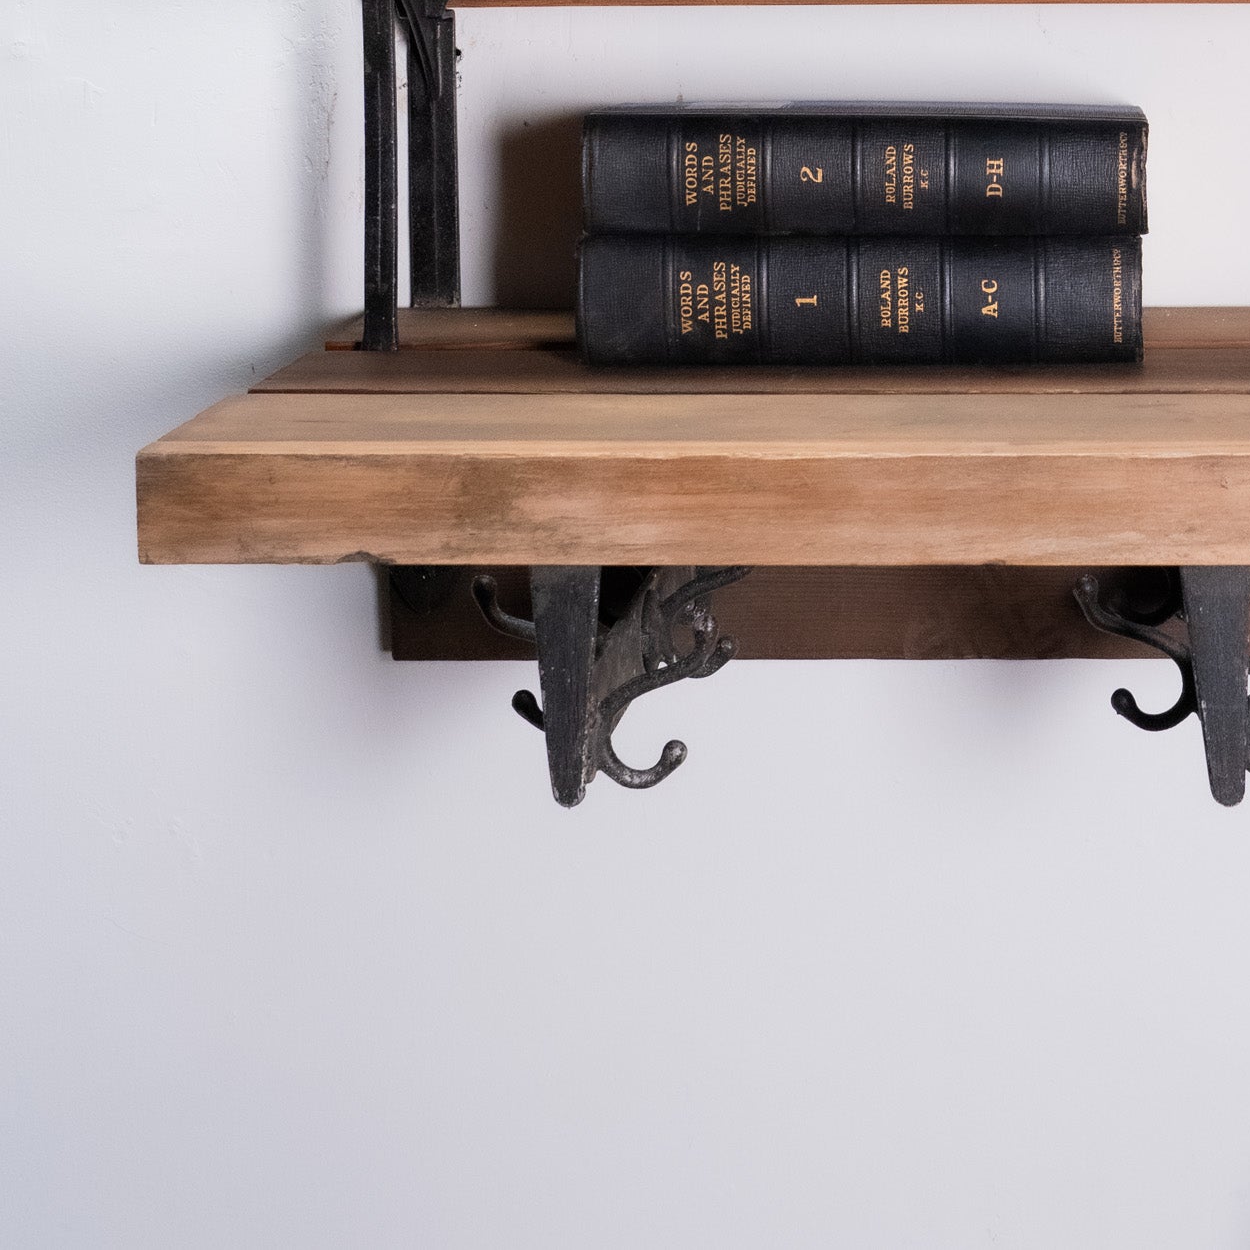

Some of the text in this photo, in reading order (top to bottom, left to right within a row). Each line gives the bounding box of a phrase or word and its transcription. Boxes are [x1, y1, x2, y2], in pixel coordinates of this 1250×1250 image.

[685, 141, 698, 206] WORDS
[702, 155, 714, 195] AND
[719, 133, 732, 211] PHRASES
[736, 136, 748, 207] JUDICIALLY
[747, 147, 756, 203] DEFINED
[800, 166, 823, 183] 2
[885, 145, 897, 204] ROLAND
[902, 143, 914, 210] BURROWS
[986, 157, 1004, 198] D-H
[680, 270, 693, 335] WORDS
[697, 284, 710, 323] AND
[713, 261, 728, 339] PHRASES
[731, 263, 744, 335] JUDICIALLY
[741, 275, 752, 330] DEFINED
[795, 294, 818, 307] 1
[880, 269, 892, 328] ROLAND
[897, 266, 909, 334] BURROWS
[981, 279, 998, 319] A-C
